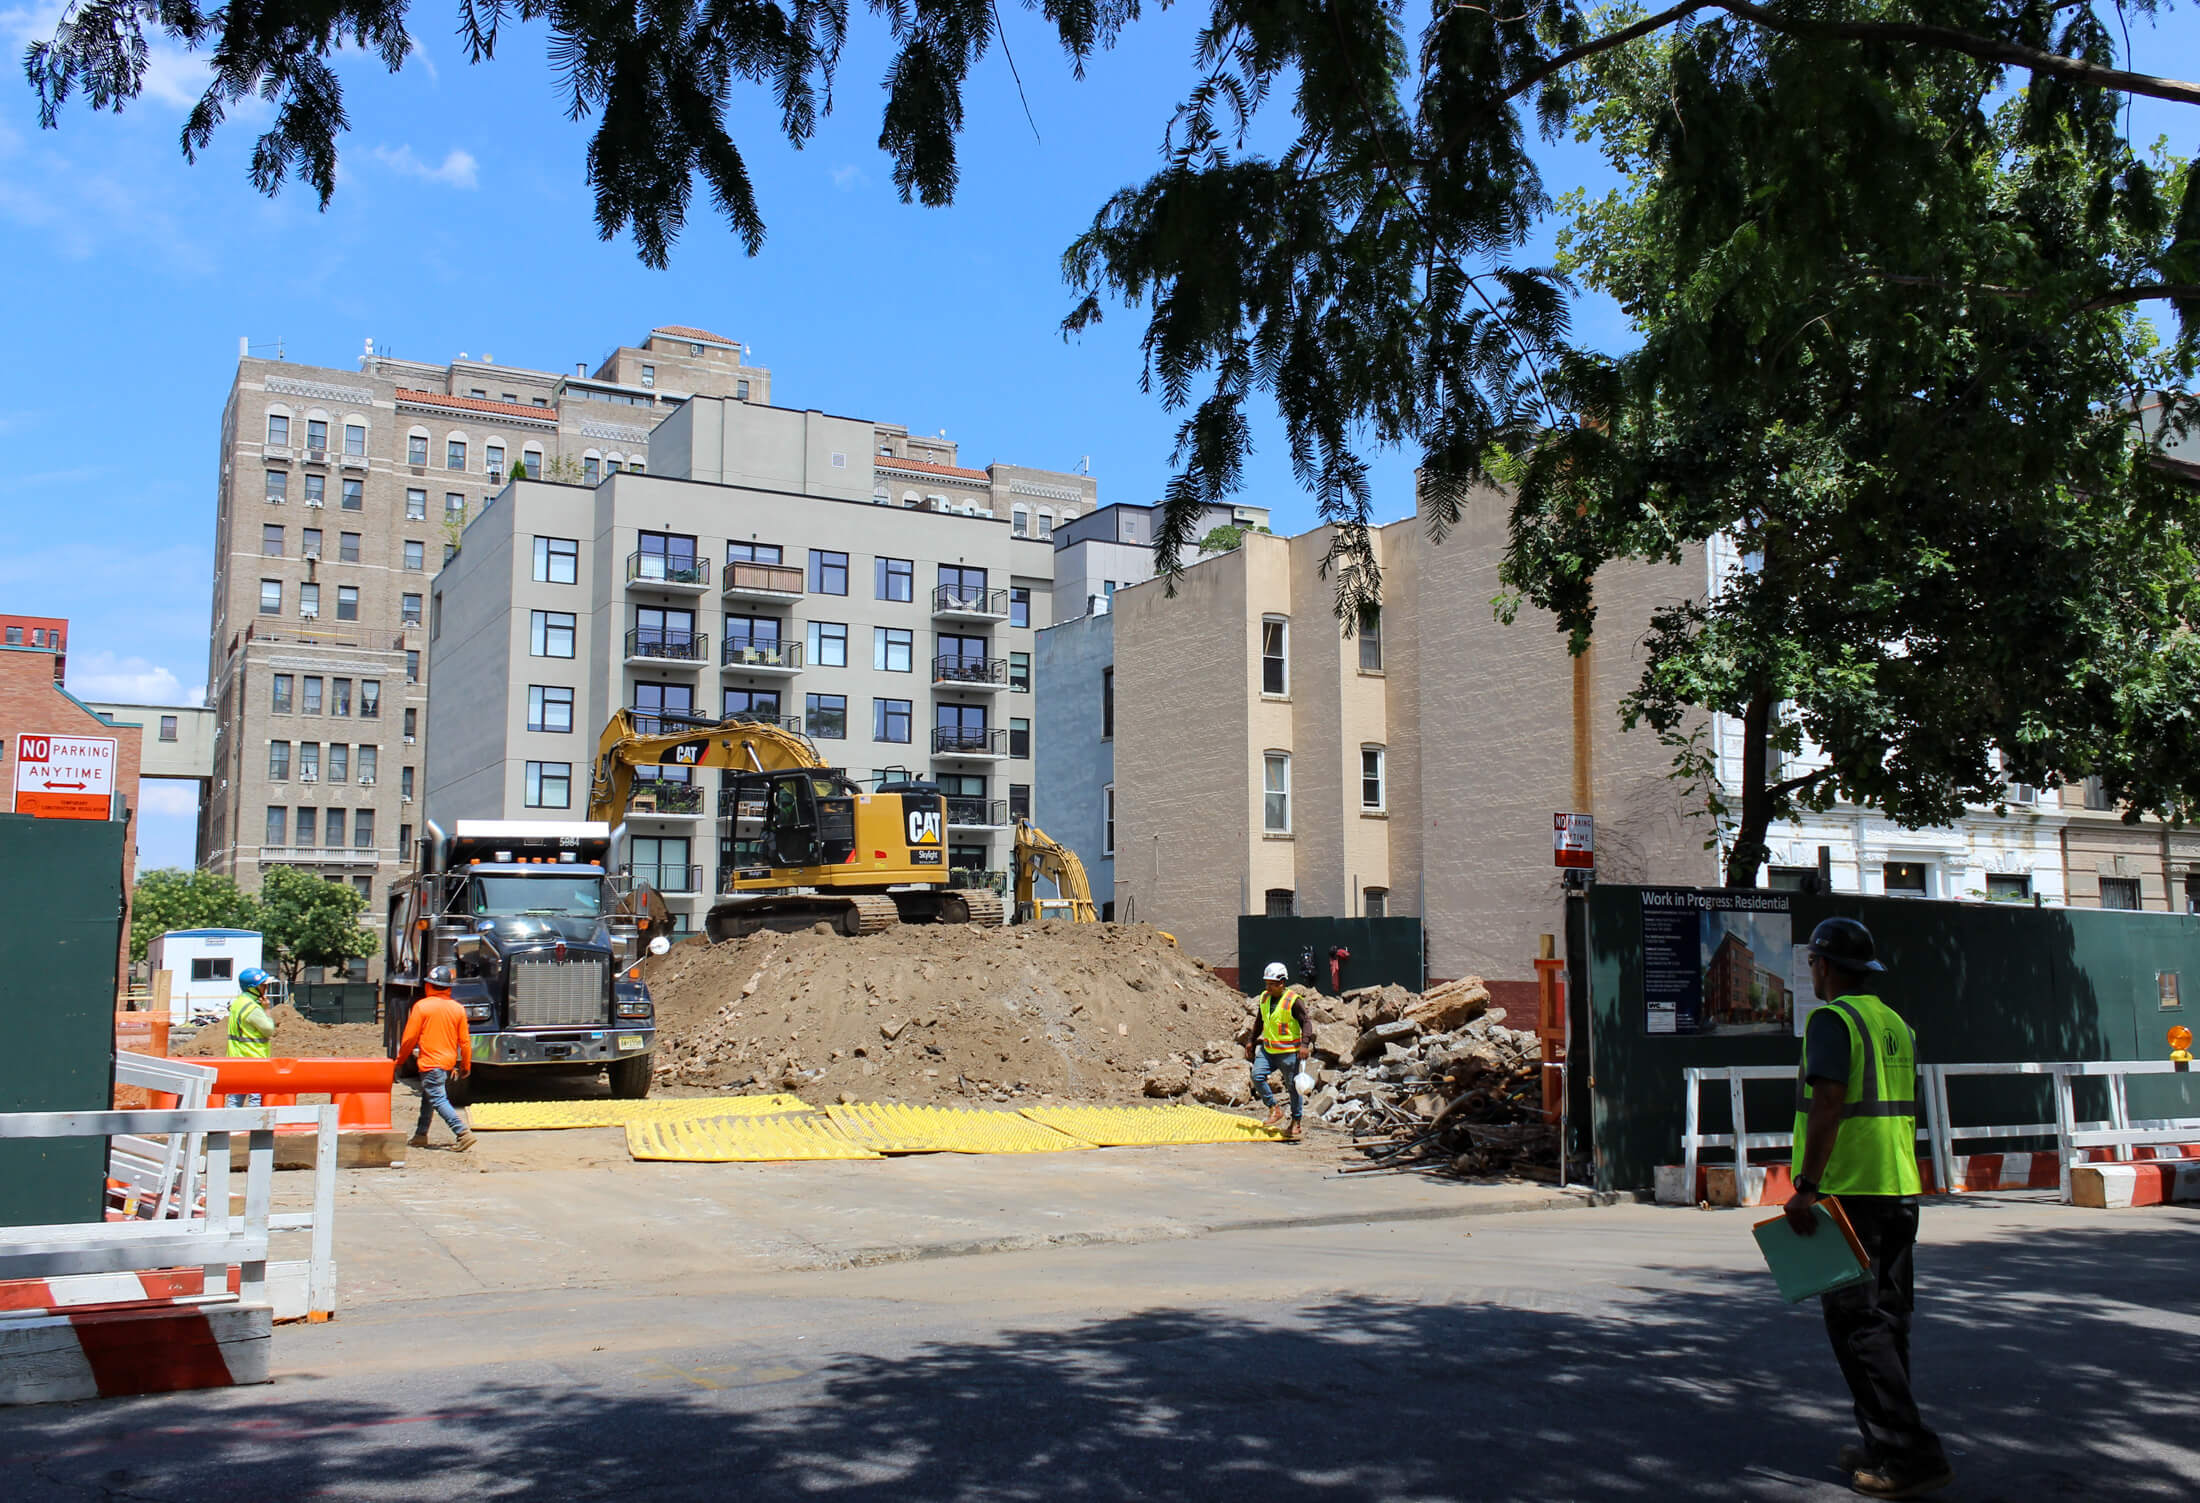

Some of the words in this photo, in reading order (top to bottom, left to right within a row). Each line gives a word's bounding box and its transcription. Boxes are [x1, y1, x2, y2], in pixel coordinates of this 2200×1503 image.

[23, 739, 48, 759] NO
[53, 744, 109, 758] PARKING
[676, 745, 698, 763] CAT
[29, 766, 102, 779] ANYTIME
[909, 811, 940, 842] CAT
[1556, 815, 1567, 828] NO
[1641, 891, 1673, 905] Work
[1675, 892, 1685, 906] in
[1687, 893, 1734, 910] Progress:
[1735, 896, 1790, 910] Residential
